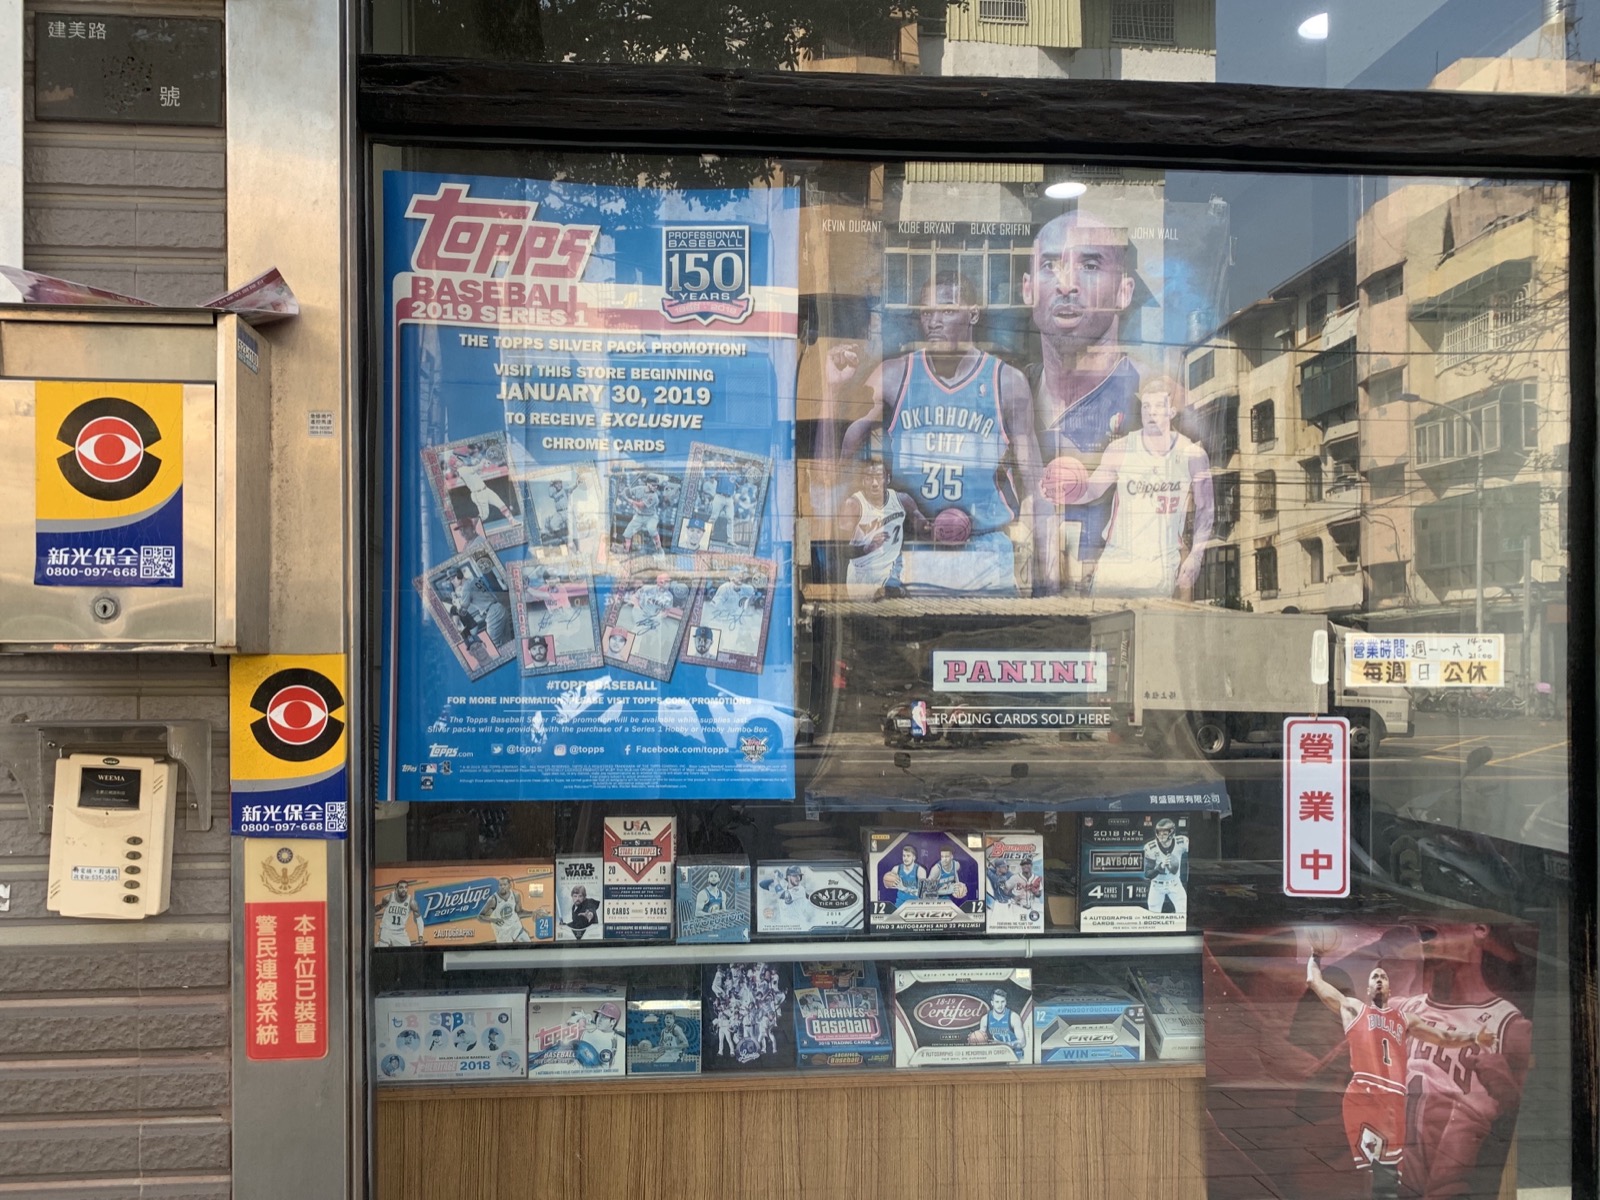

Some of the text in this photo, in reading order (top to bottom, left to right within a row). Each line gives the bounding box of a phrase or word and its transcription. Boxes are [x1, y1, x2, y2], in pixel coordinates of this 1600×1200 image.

[47, 21, 107, 40] 建美路
[159, 86, 181, 107] 號
[668, 231, 743, 240] PROFESSIONAL
[822, 220, 1178, 240] KEVIN DURANT KOBE BRYANT BLAKE GRIFFIN JOHN WALL
[668, 240, 743, 248] BASEBALL
[669, 252, 743, 291] 150
[411, 276, 578, 309] BASEBALL
[411, 301, 589, 327] 2019 SERIES 1
[459, 333, 747, 356] THE TOPPS SILVER PACK PROMOTION!
[493, 363, 714, 382] VISIT THIS STORE BEGINNING
[496, 382, 711, 407] JANUARY 30, 2019
[505, 412, 703, 429] TO RECEIVE EXCLUSIVE
[900, 405, 995, 439] OKLAHOMA
[542, 437, 666, 452] CHROME CARDS
[925, 431, 964, 454] CITY
[921, 461, 964, 501] 35
[1127, 479, 1181, 498] Clippers
[1156, 496, 1181, 514] 32
[46, 547, 139, 566] 新光保全
[46, 567, 138, 577] 0800-097-668
[943, 659, 1097, 684] PANINI
[447, 696, 466, 705] FOR
[469, 696, 497, 705] MORE
[607, 697, 630, 705] VISIT
[466, 716, 488, 726] Topps
[491, 716, 525, 724] Baseball
[614, 716, 628, 724] will
[630, 716, 640, 724] be
[677, 716, 697, 724] while
[932, 712, 1111, 726] TRADING CARDS SOLD HERE
[452, 727, 476, 735] packs
[576, 726, 612, 735] purchase
[665, 726, 688, 735] Hobby
[701, 726, 724, 735] Hobby
[506, 746, 542, 755] @topps
[569, 746, 604, 755] @topps
[636, 745, 729, 755] Facebook.com/topps
[97, 774, 125, 782] WEEMA
[241, 804, 323, 822] 新光保全
[1298, 731, 1334, 881] 營業中
[241, 823, 323, 832] 0800-097-668
[623, 821, 651, 831] USA
[1095, 856, 1140, 866] PLAYBOOK
[565, 869, 595, 877] WARS
[608, 866, 616, 875] 20
[659, 866, 666, 875] 19
[1088, 885, 1104, 899] 4
[1126, 885, 1133, 899] 1
[423, 884, 493, 918] Prestige
[873, 902, 886, 914] 12
[971, 902, 984, 912] 12
[434, 905, 469, 917] 2017-18
[391, 916, 402, 925] 11
[539, 918, 549, 930] 24
[256, 915, 279, 1046] 警民連線系統
[293, 914, 317, 1044] 本單位已裝置
[818, 1008, 865, 1019] ARCHIVES
[919, 998, 983, 1027] Certified
[1036, 1011, 1046, 1022] 12
[812, 1018, 872, 1034] Baseball
[1367, 1014, 1403, 1046] BULLS
[544, 1050, 576, 1058] BASEBALL
[1063, 1050, 1088, 1059] WIN
[1382, 1038, 1392, 1066] 1
[460, 1061, 491, 1071] 2018
